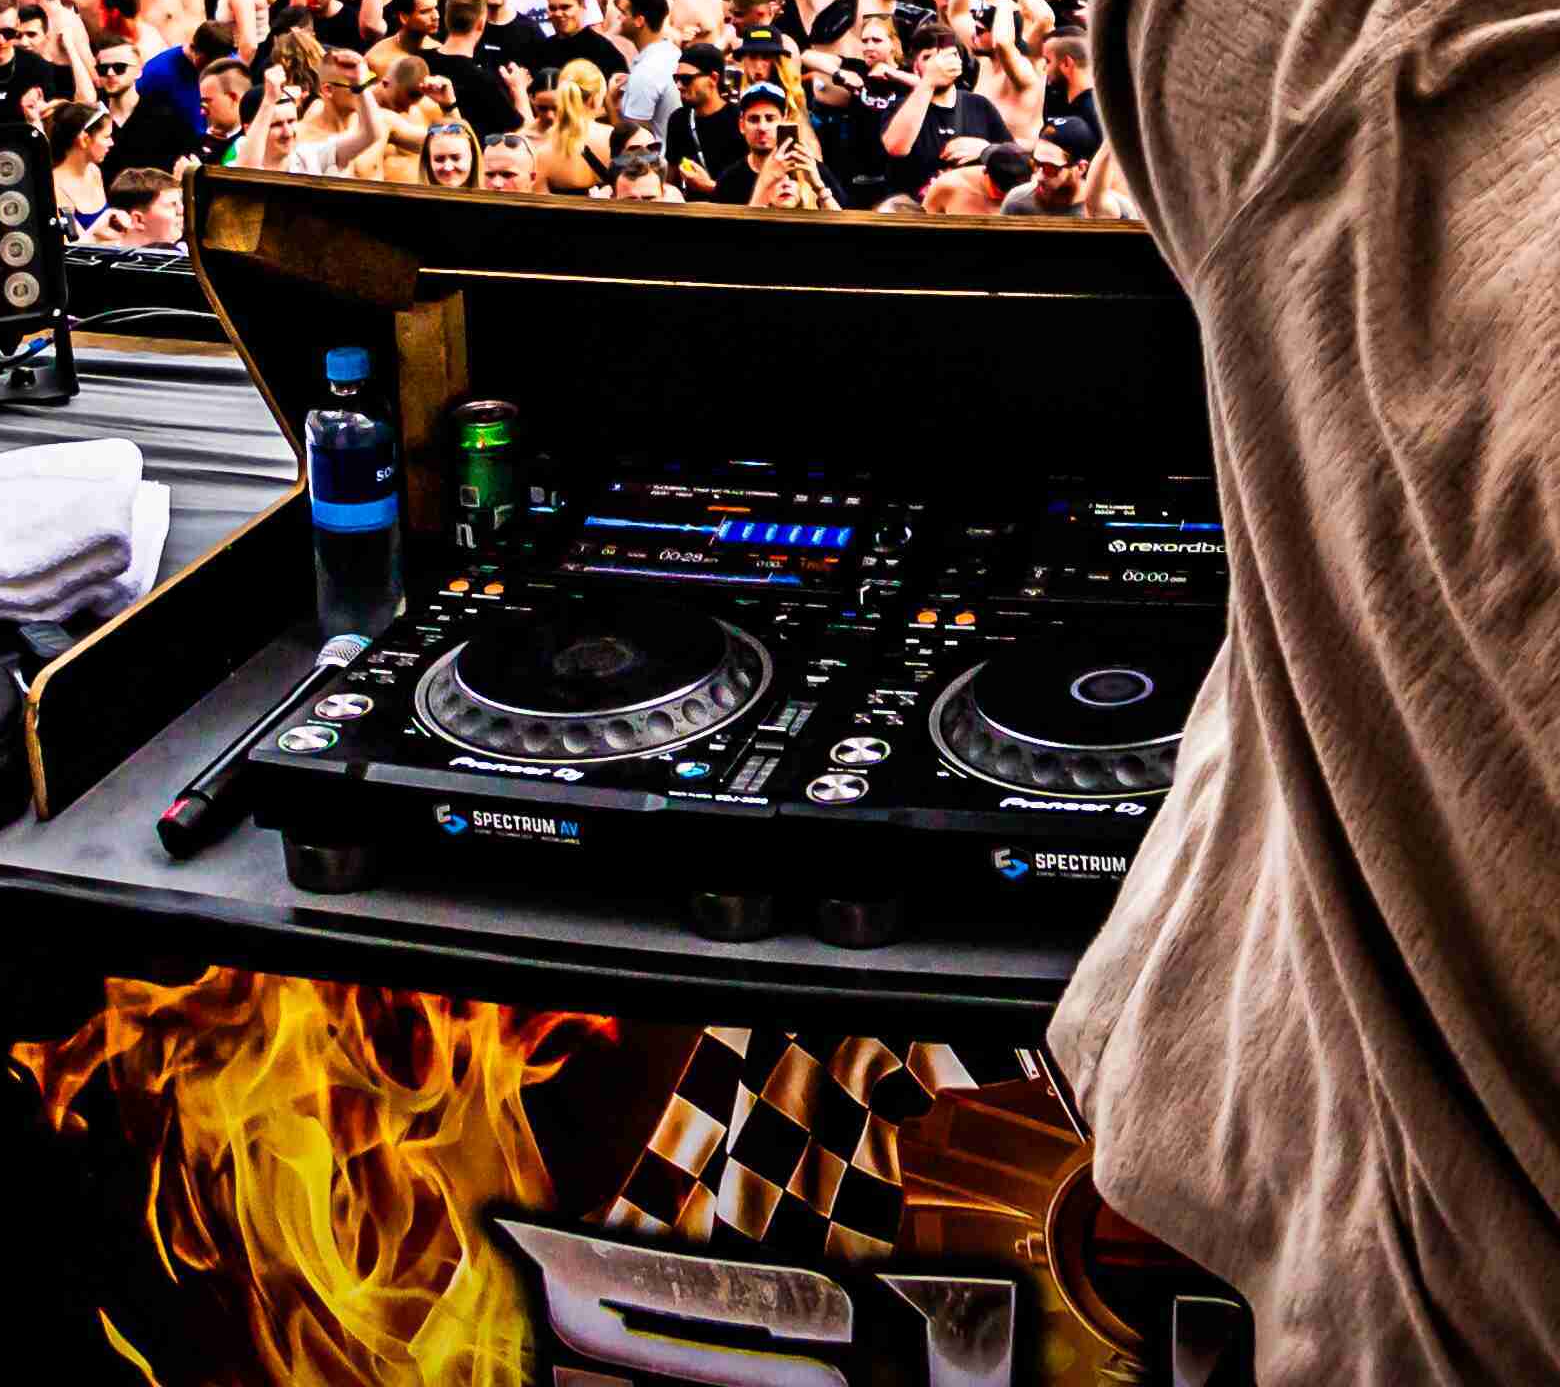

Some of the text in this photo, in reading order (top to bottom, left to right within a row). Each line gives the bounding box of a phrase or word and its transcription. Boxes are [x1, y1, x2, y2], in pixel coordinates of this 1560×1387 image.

[1130, 541, 1225, 554] rekordbo
[472, 810, 556, 836] SPECTRUM
[560, 819, 579, 837] AV
[1035, 852, 1127, 873] SPECTRUM
